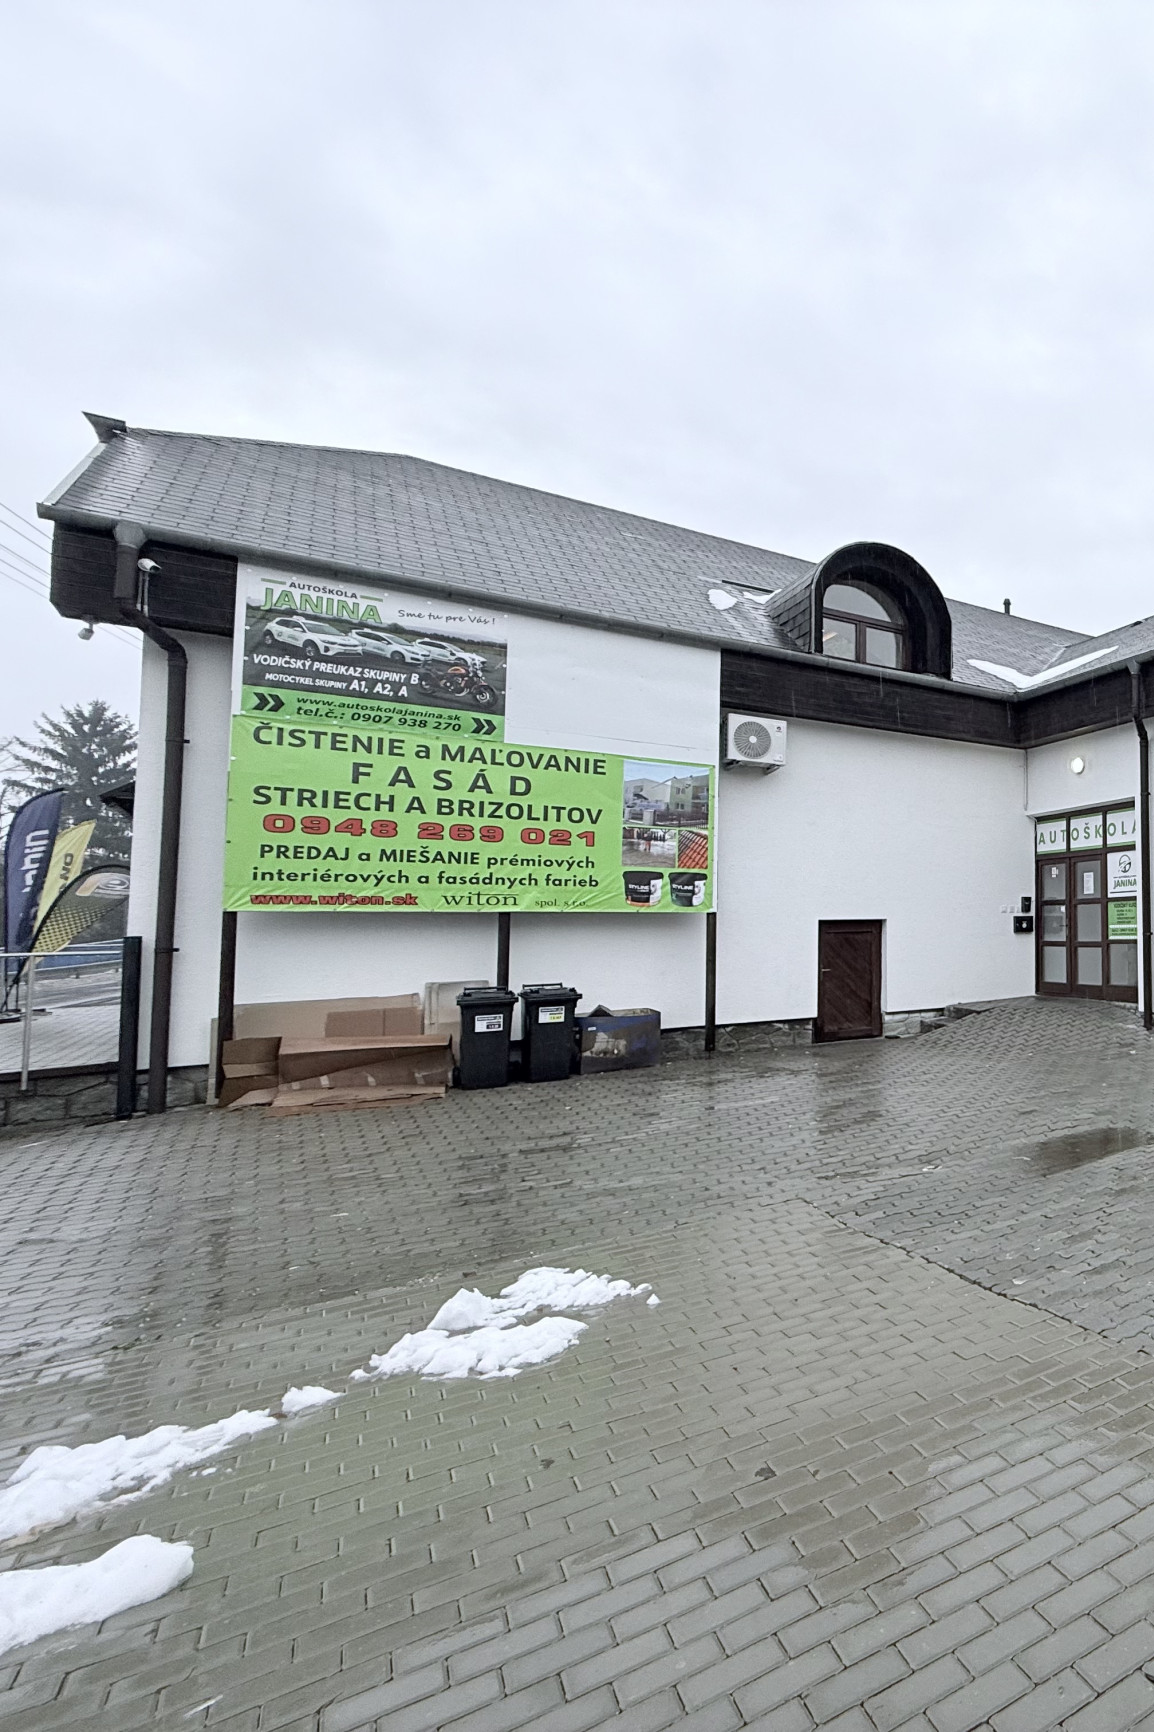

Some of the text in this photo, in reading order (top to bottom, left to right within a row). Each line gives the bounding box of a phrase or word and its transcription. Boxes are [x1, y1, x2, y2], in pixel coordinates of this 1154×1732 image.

[289, 581, 358, 599] AUTOŠKOLA
[260, 587, 383, 624] JANINA
[398, 609, 425, 619] Sme
[428, 612, 442, 620] tu
[445, 615, 466, 623] pre
[253, 653, 420, 685] VODIČSKÝ PREUKAZ SKUPINY B
[265, 672, 408, 698] MOTOCYKEL SKUPINY A1, A2, A
[296, 706, 462, 732] tel.č.: 0907 938 270
[297, 697, 462, 722] www.autoskolajanina.sk
[253, 721, 607, 775] ČISTENIE a MAĽOVANIE
[252, 785, 603, 825] STRIECH A BRIZOLITOV
[262, 813, 595, 847] 0948 269 021
[259, 844, 595, 871] PREDAJ a MIEŠANIE prémiových
[252, 866, 599, 889] interiérových a fasádnych farieb
[1113, 878, 1137, 890] JANINA
[250, 892, 418, 906] www.witon.sk
[442, 891, 519, 906] witon
[535, 898, 560, 908] spol.
